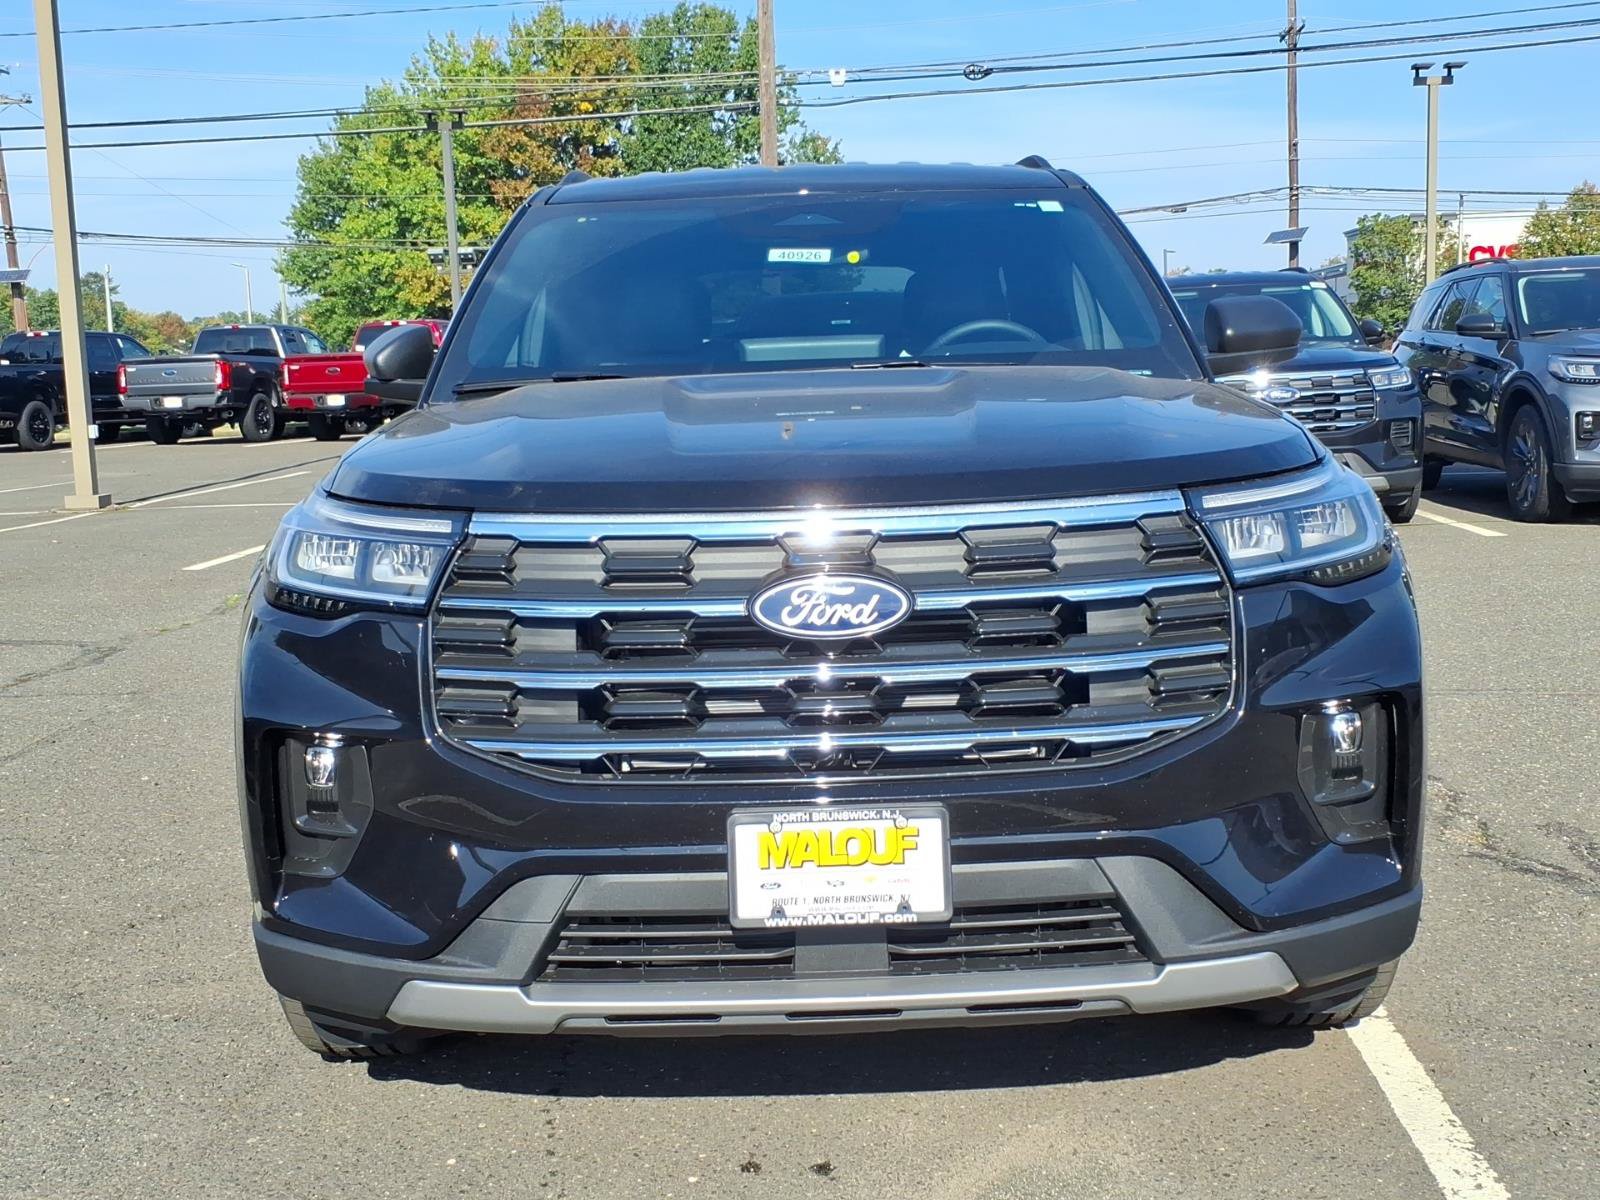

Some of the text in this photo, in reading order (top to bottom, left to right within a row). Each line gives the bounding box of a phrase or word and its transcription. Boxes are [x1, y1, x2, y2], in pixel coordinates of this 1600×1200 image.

[778, 251, 821, 260] 40926
[780, 584, 881, 626] Ford
[773, 812, 810, 823] NORTH
[757, 826, 920, 870] MALOUF
[771, 896, 799, 907] ROUTE
[813, 894, 842, 905] NORTH
[764, 912, 918, 927] www.MALOUF.com
